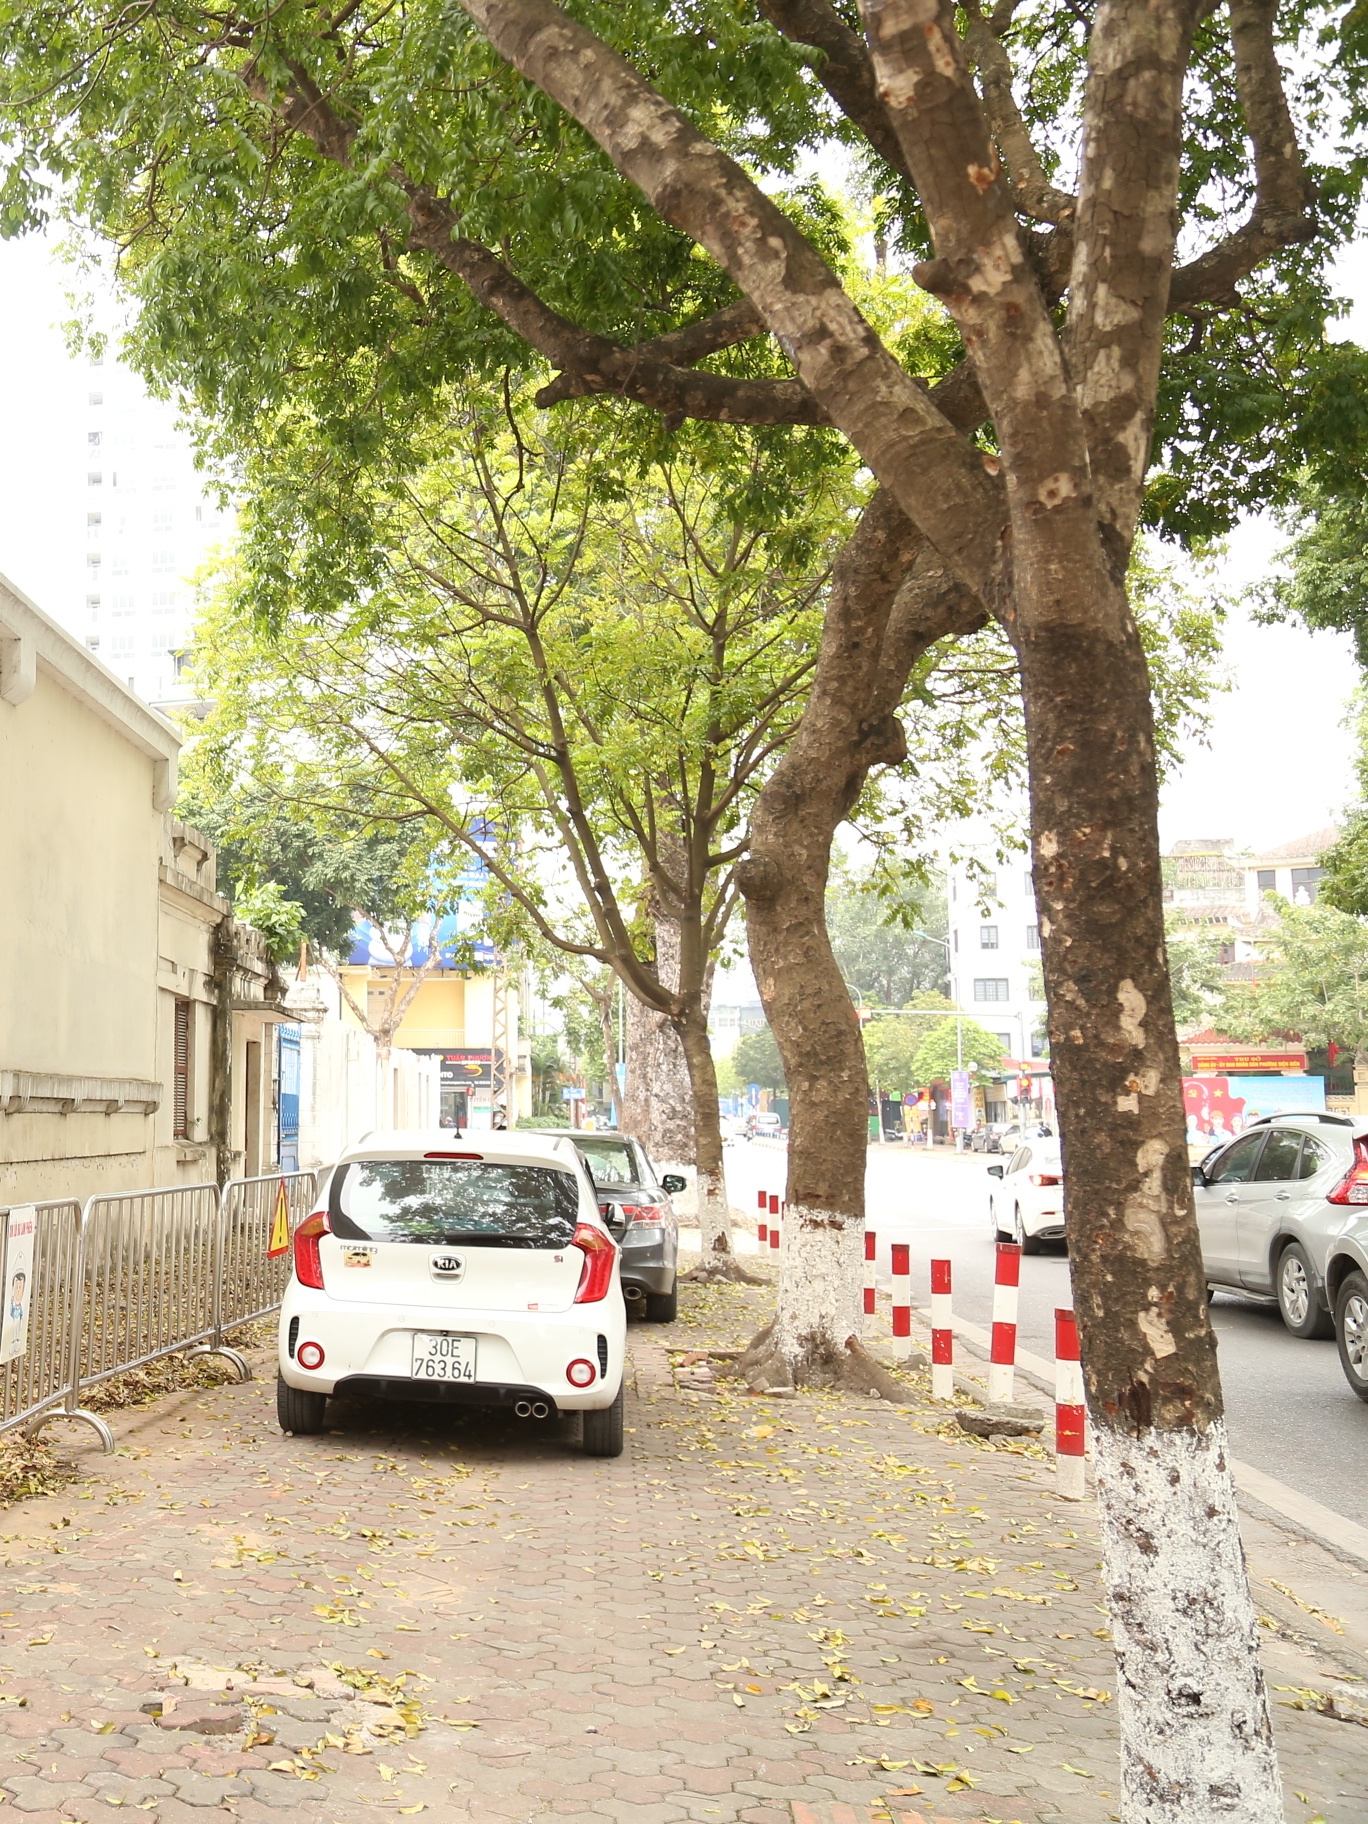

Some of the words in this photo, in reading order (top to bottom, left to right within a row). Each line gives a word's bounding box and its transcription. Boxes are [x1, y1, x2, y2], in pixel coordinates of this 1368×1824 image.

[436, 1258, 458, 1270] KIA
[428, 1338, 461, 1358] 30E
[414, 1358, 473, 1380] 763.64
